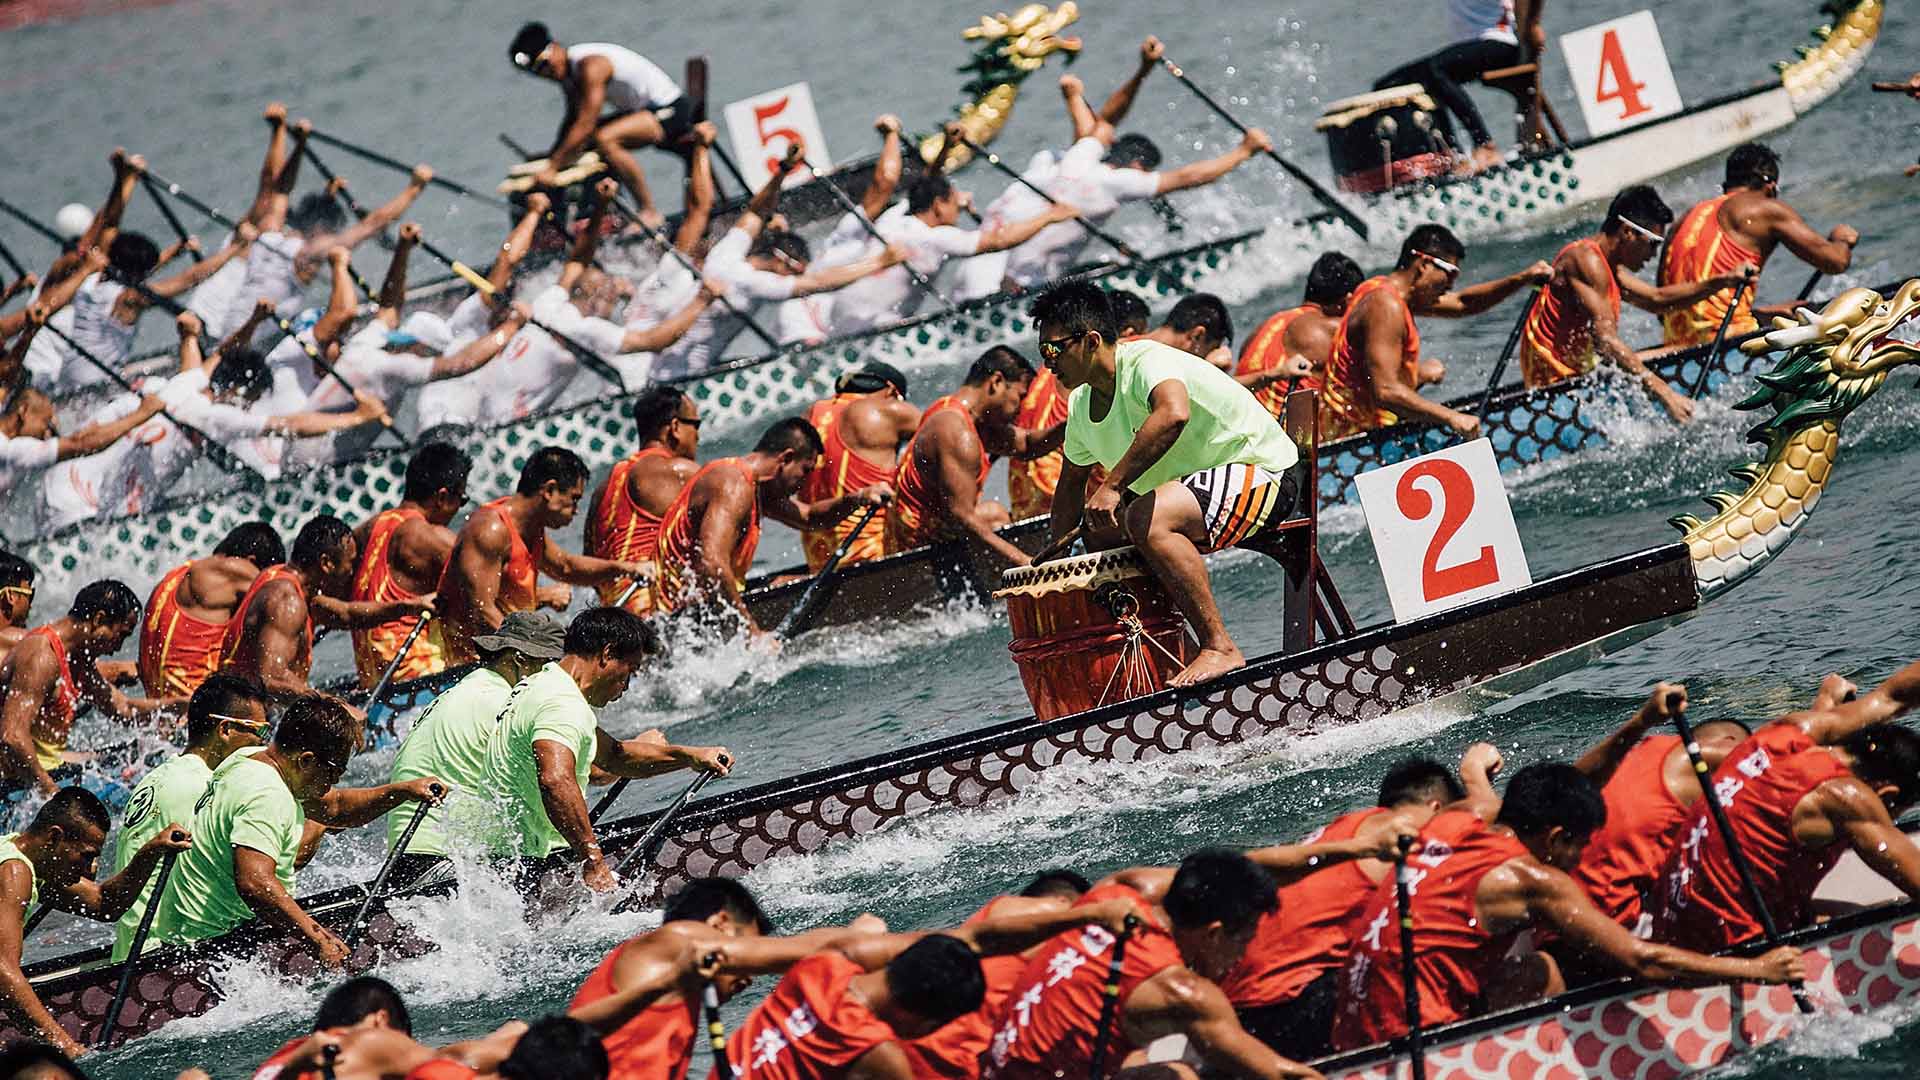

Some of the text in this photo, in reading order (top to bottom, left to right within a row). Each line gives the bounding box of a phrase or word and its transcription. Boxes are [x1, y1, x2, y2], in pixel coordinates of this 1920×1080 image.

[1596, 31, 1650, 120] 4
[754, 96, 806, 177] 5
[1396, 458, 1500, 602] 2
